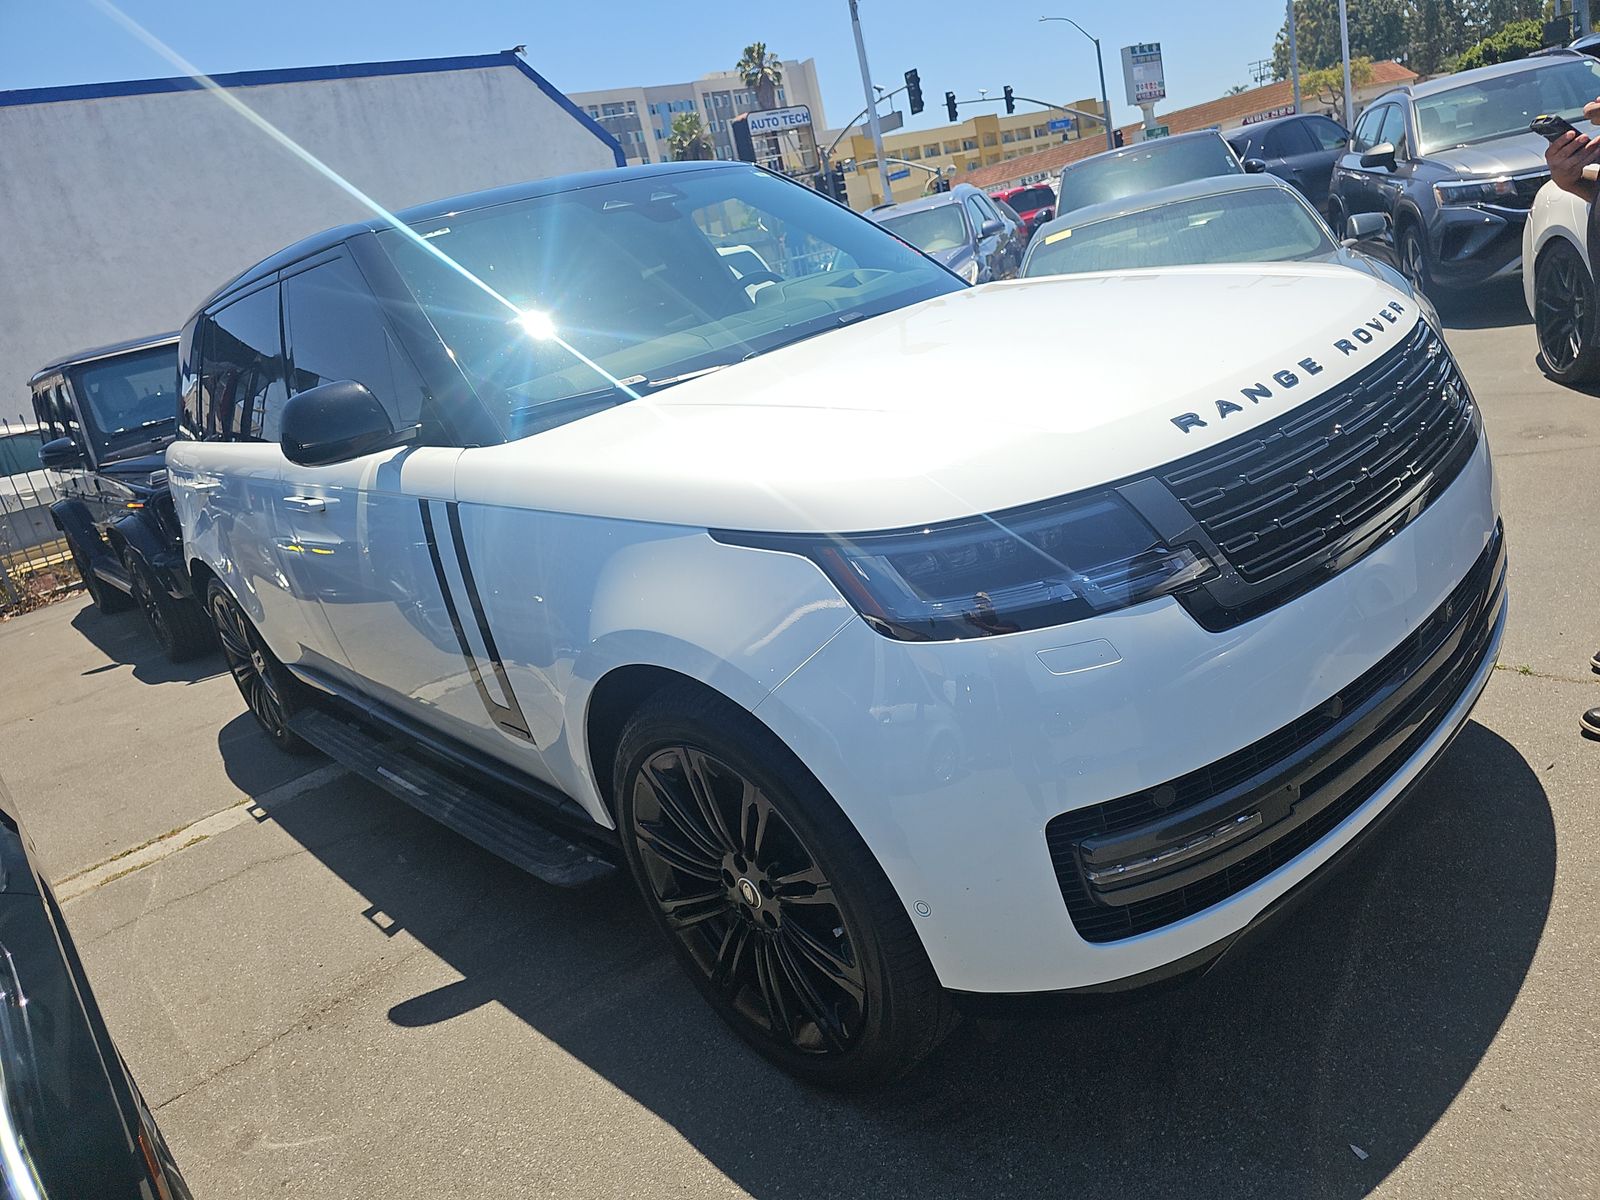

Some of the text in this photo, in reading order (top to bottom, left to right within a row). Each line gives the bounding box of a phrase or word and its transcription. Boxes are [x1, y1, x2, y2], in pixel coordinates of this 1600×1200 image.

[751, 117, 780, 130] AUTO
[781, 112, 810, 125] TECH
[1170, 300, 1406, 434] RANGE ROVER
